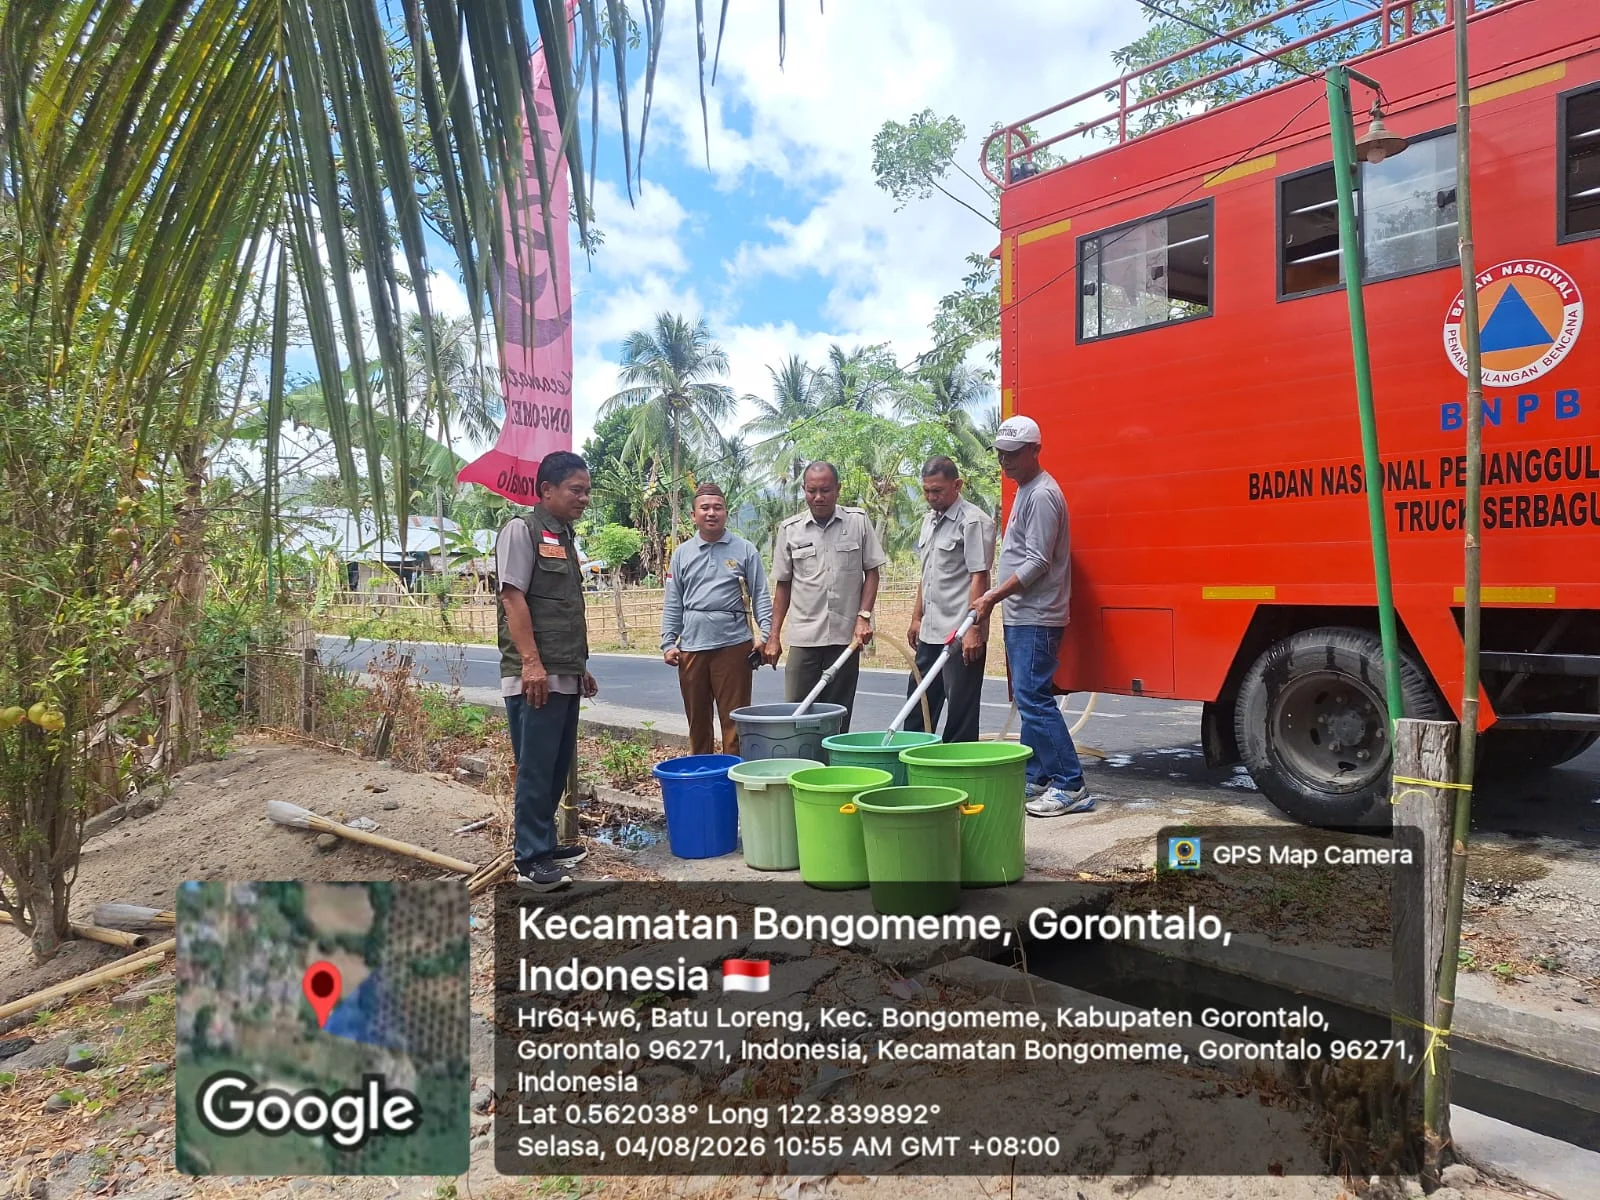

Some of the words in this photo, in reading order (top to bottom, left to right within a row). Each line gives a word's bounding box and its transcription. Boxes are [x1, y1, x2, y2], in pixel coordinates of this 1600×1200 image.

[1451, 274, 1493, 317] BAAN
[1501, 263, 1575, 300] NASIONAL
[1542, 309, 1579, 367] BENCANA
[1440, 388, 1582, 432] BNPB
[1249, 468, 1314, 500] BADAN
